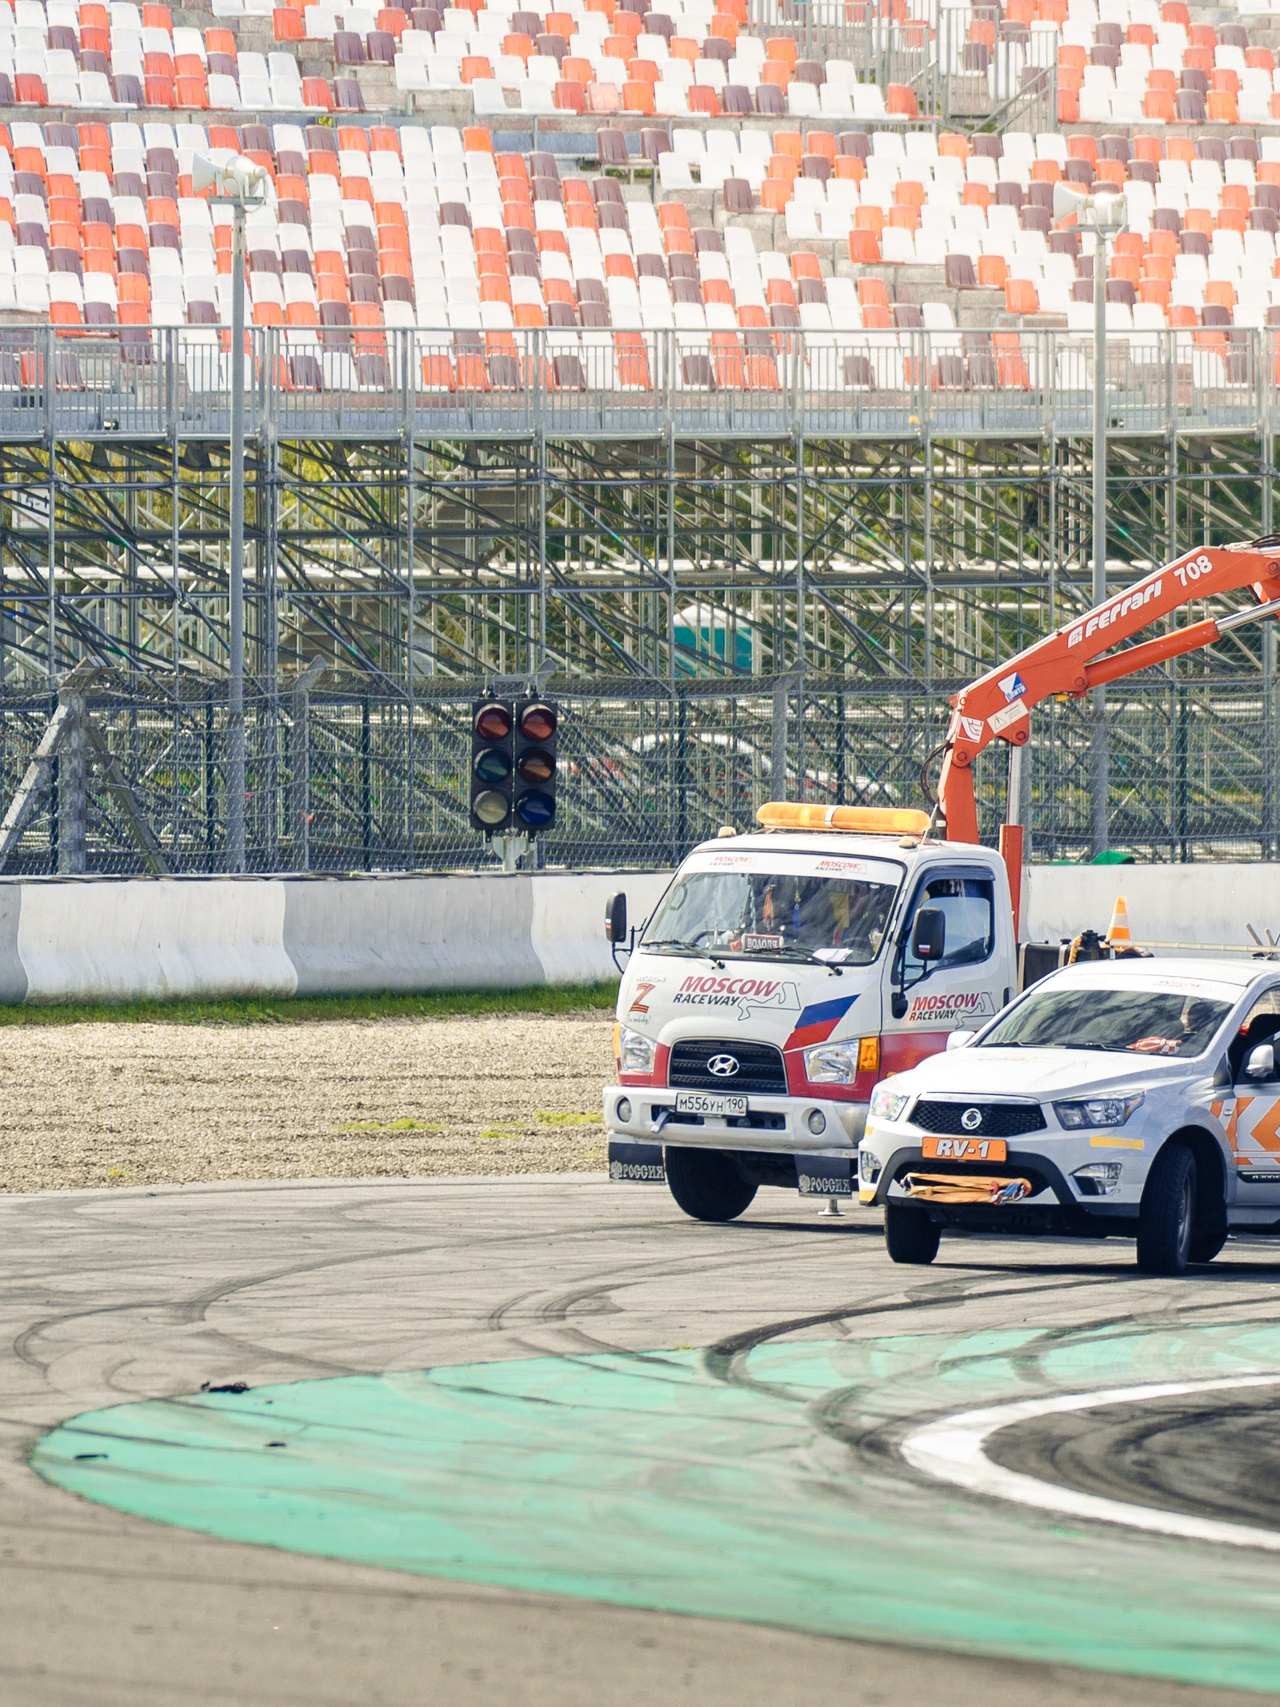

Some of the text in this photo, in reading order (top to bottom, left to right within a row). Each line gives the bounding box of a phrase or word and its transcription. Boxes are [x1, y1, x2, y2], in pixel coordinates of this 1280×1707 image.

[1085, 555, 1213, 638] Ferrari 708
[819, 860, 860, 869] MOSCOW
[679, 976, 781, 997] MOSCOW
[672, 993, 740, 1006] RACEWAY
[912, 993, 980, 1011] MOSCOW
[909, 1010, 956, 1021] RACEWAY
[727, 1098, 744, 1110] 190
[936, 1139, 990, 1158] RV-1
[621, 1164, 665, 1180] РОССИЯ
[810, 1176, 851, 1193] РОССИЯ
